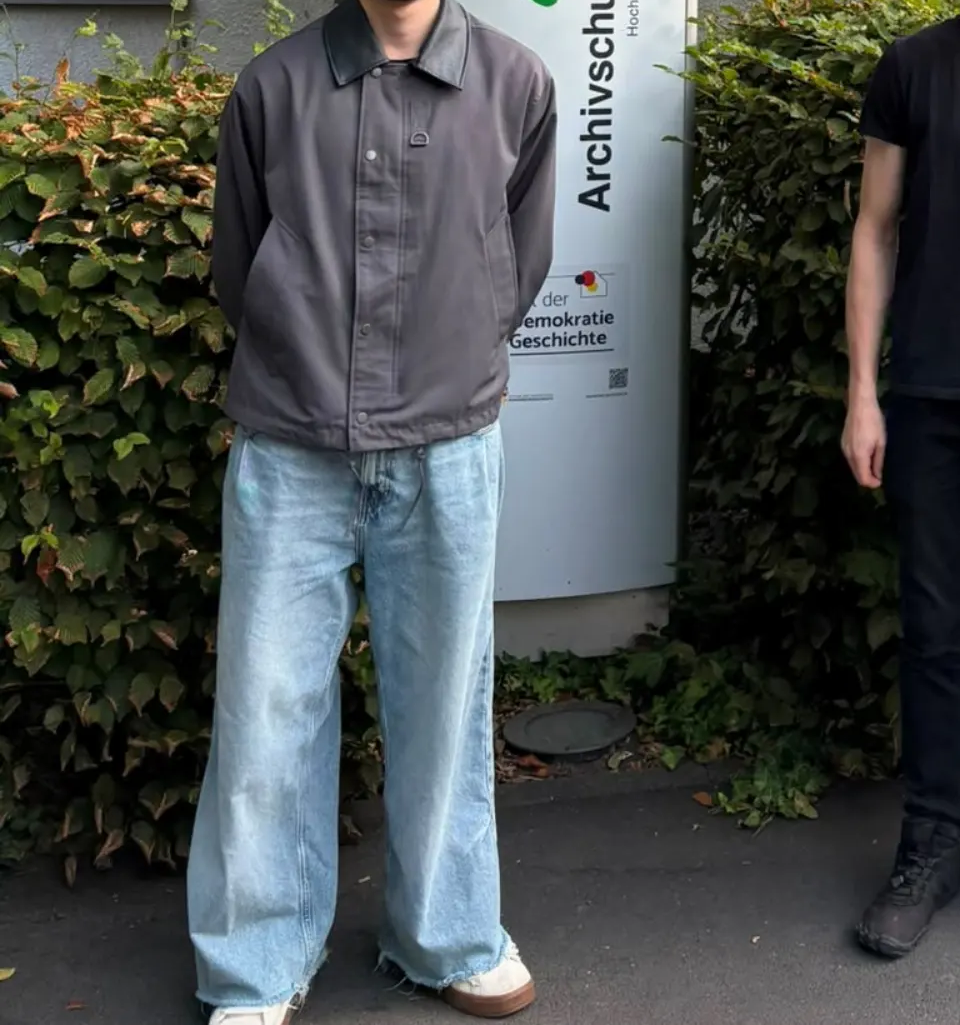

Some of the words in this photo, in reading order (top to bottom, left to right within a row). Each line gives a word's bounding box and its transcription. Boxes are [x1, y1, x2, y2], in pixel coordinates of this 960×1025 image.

[542, 291, 569, 307] der
[518, 310, 615, 329] emokratie
[509, 330, 607, 349] Geschichte
